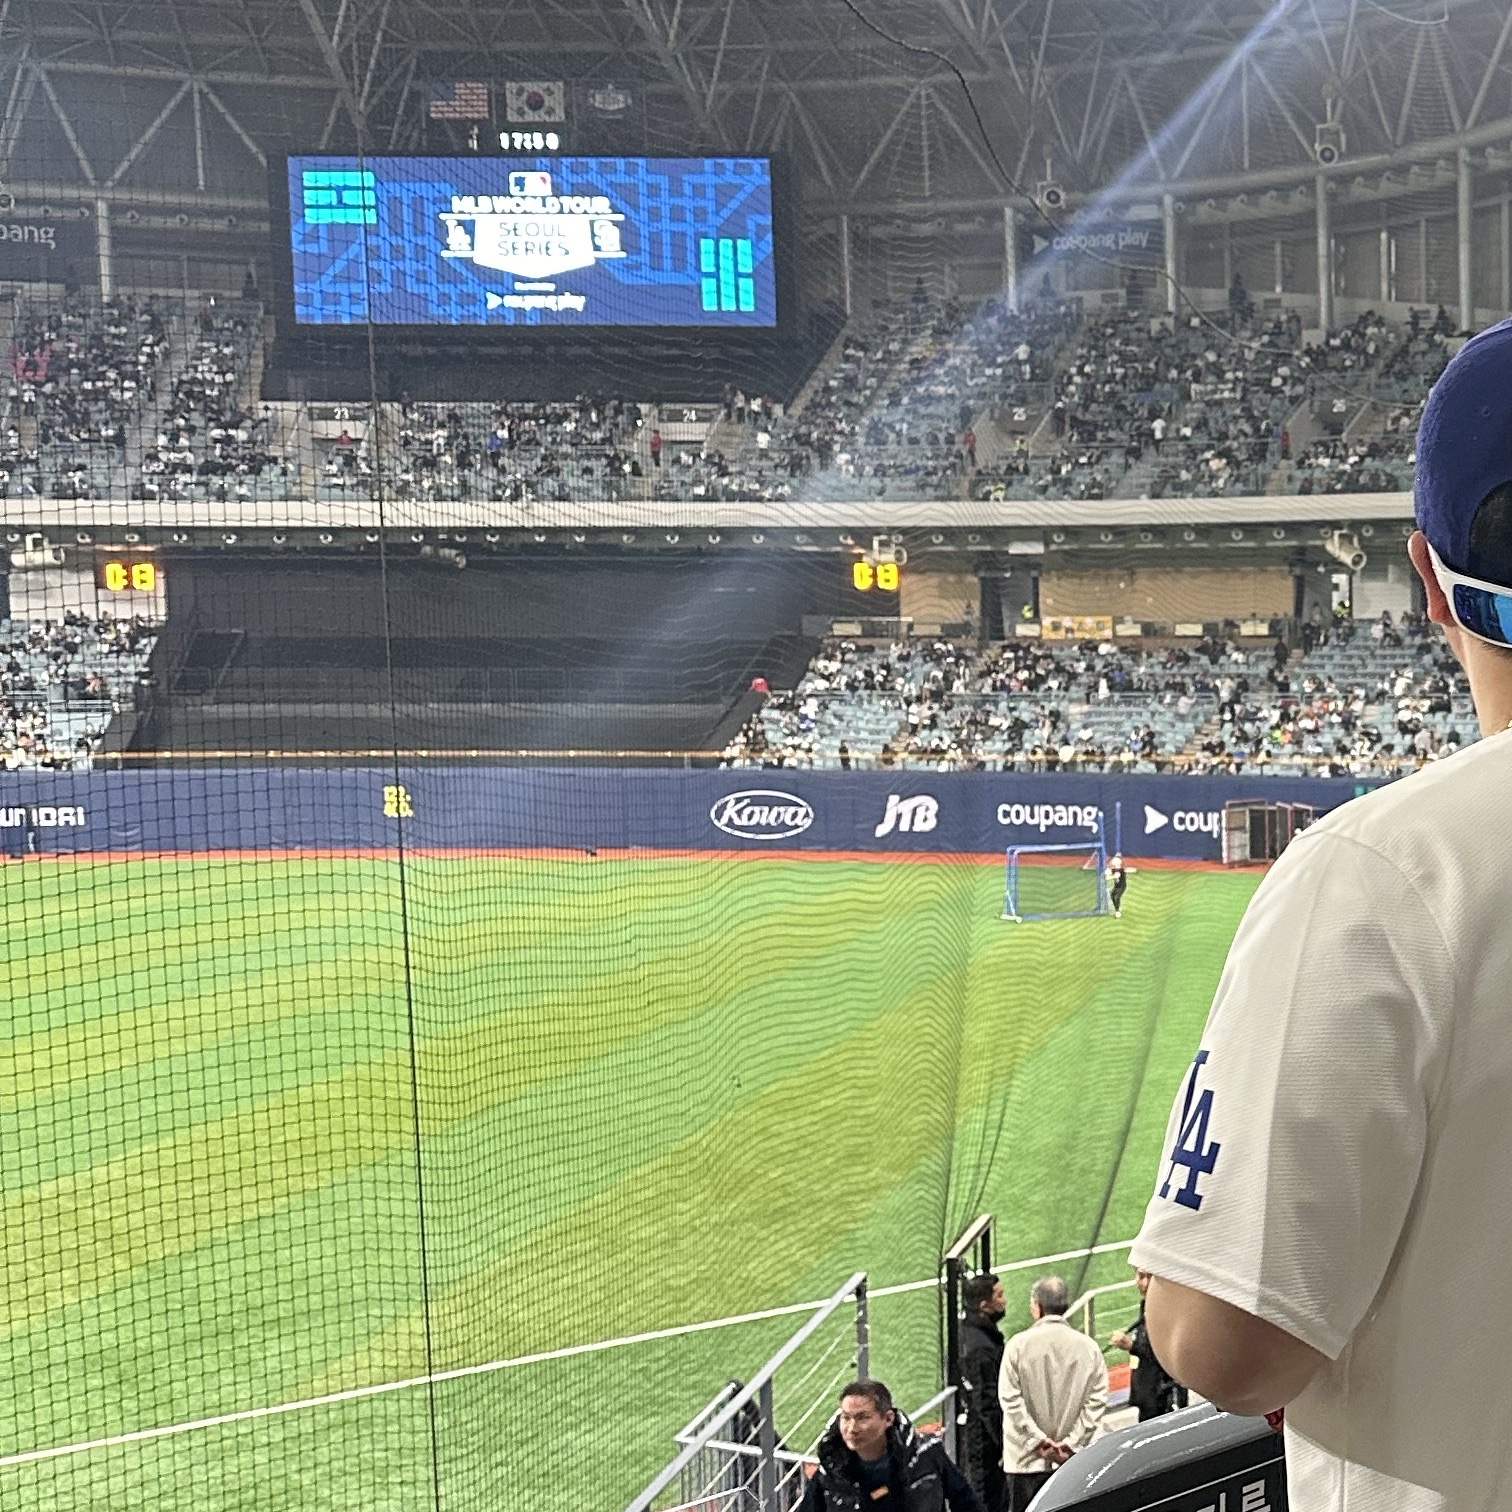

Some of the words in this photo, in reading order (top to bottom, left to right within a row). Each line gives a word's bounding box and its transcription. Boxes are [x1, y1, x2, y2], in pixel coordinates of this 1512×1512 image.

[498, 222, 567, 237] SEOUL
[496, 241, 571, 257] SERIES
[720, 797, 807, 827] Kowa
[874, 794, 939, 838] JTB
[997, 803, 1099, 834] coupang
[1173, 810, 1220, 839] coup
